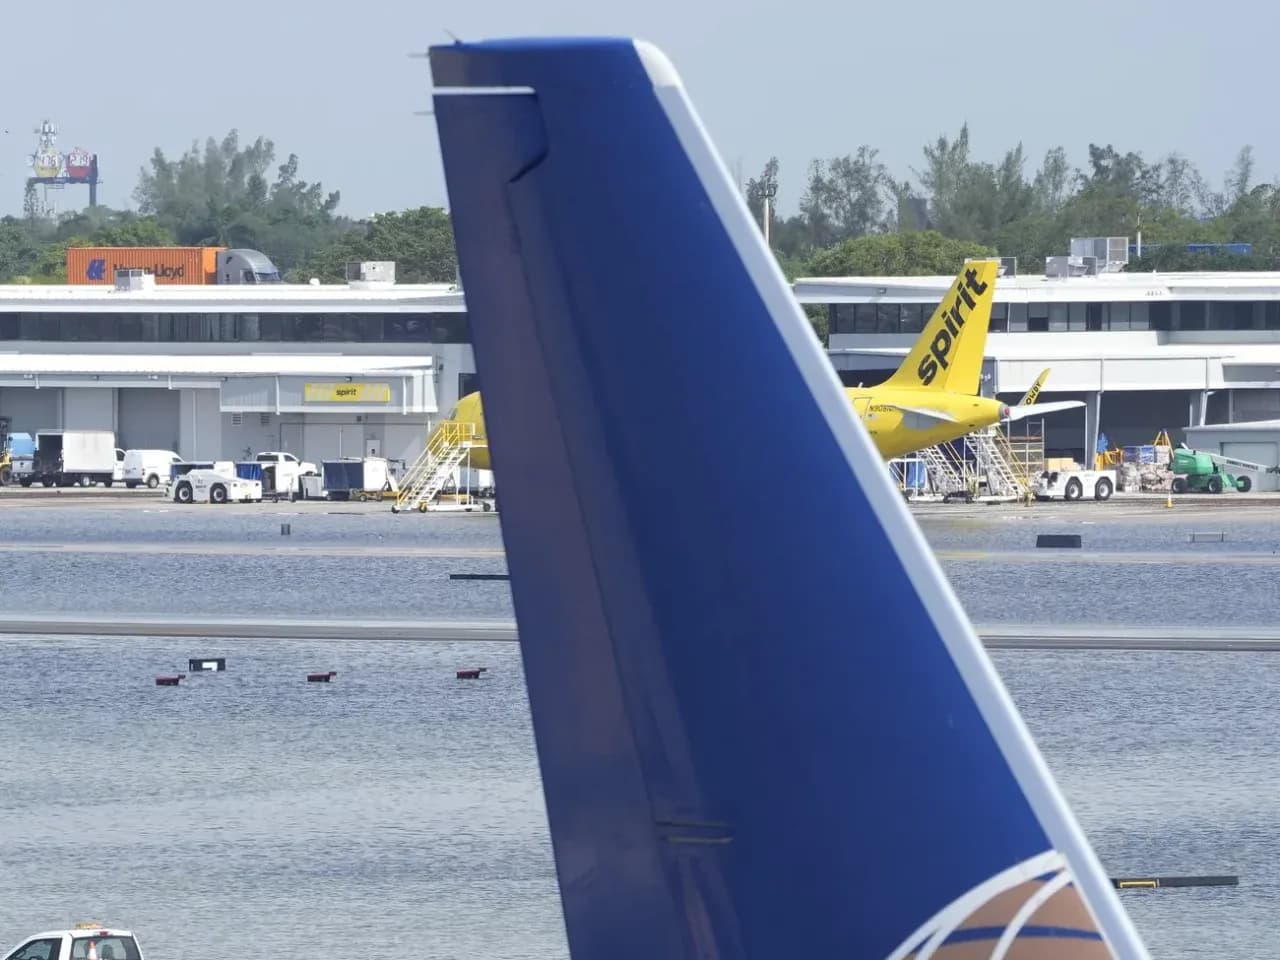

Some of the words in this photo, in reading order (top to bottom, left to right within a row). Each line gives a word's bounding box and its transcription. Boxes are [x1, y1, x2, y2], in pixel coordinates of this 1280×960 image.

[917, 267, 988, 386] spirit
[336, 389, 357, 397] spirit
[1025, 380, 1042, 405] OWDY
